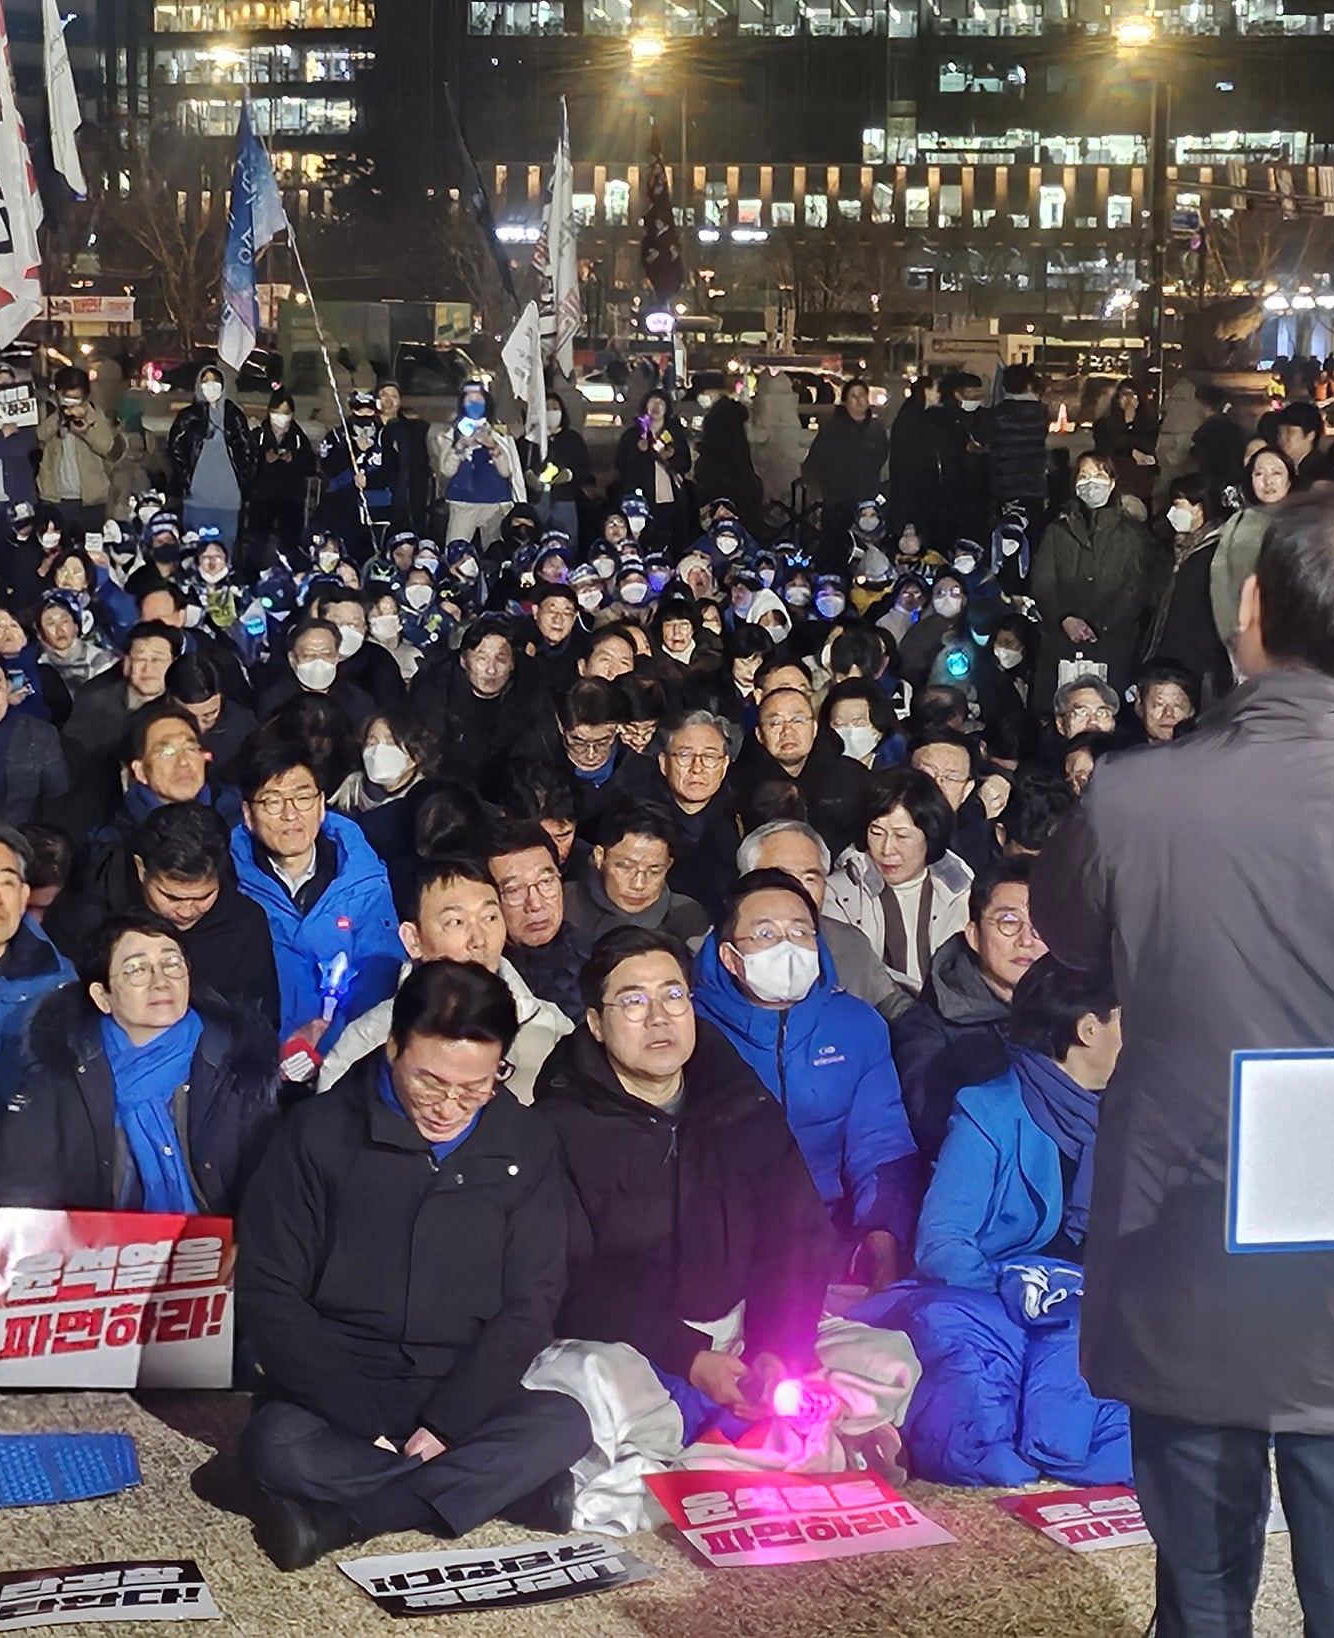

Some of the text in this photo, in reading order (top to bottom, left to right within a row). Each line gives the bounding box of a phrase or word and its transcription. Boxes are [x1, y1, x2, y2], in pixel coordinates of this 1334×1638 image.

[6, 1237, 223, 1301] 윤석열을
[681, 1480, 886, 1525] 윤석열을
[700, 1506, 920, 1556] 파면하라!
